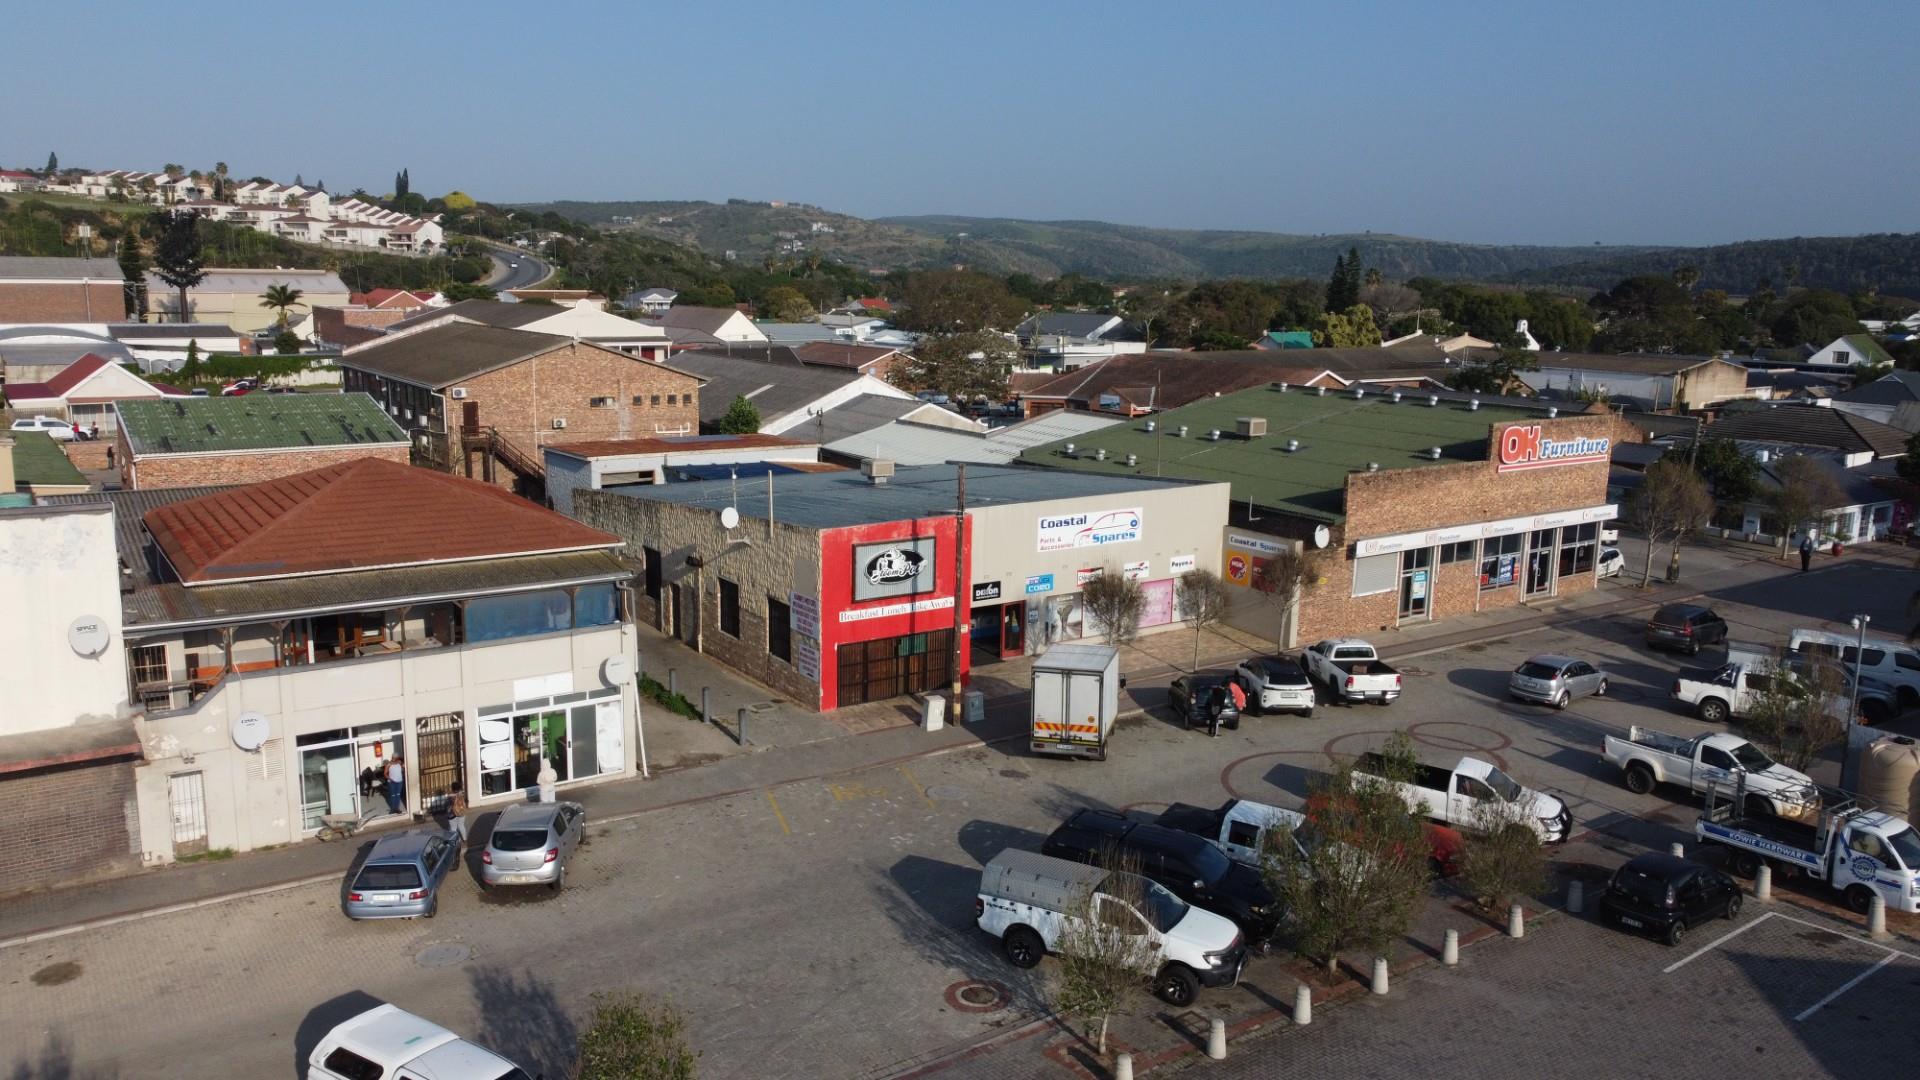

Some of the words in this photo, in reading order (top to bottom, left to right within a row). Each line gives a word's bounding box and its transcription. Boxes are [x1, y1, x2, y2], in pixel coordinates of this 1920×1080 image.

[1502, 426, 1540, 464] OK
[1541, 438, 1609, 458] Furniture
[1041, 515, 1087, 529] Coastal
[1092, 532, 1136, 544] Spares
[1230, 536, 1257, 548] Coastal
[840, 608, 879, 621] Breakfast
[881, 602, 907, 615] Lunch
[1729, 831, 1756, 846] KOWIE
[1760, 842, 1807, 860] HARDWARE
